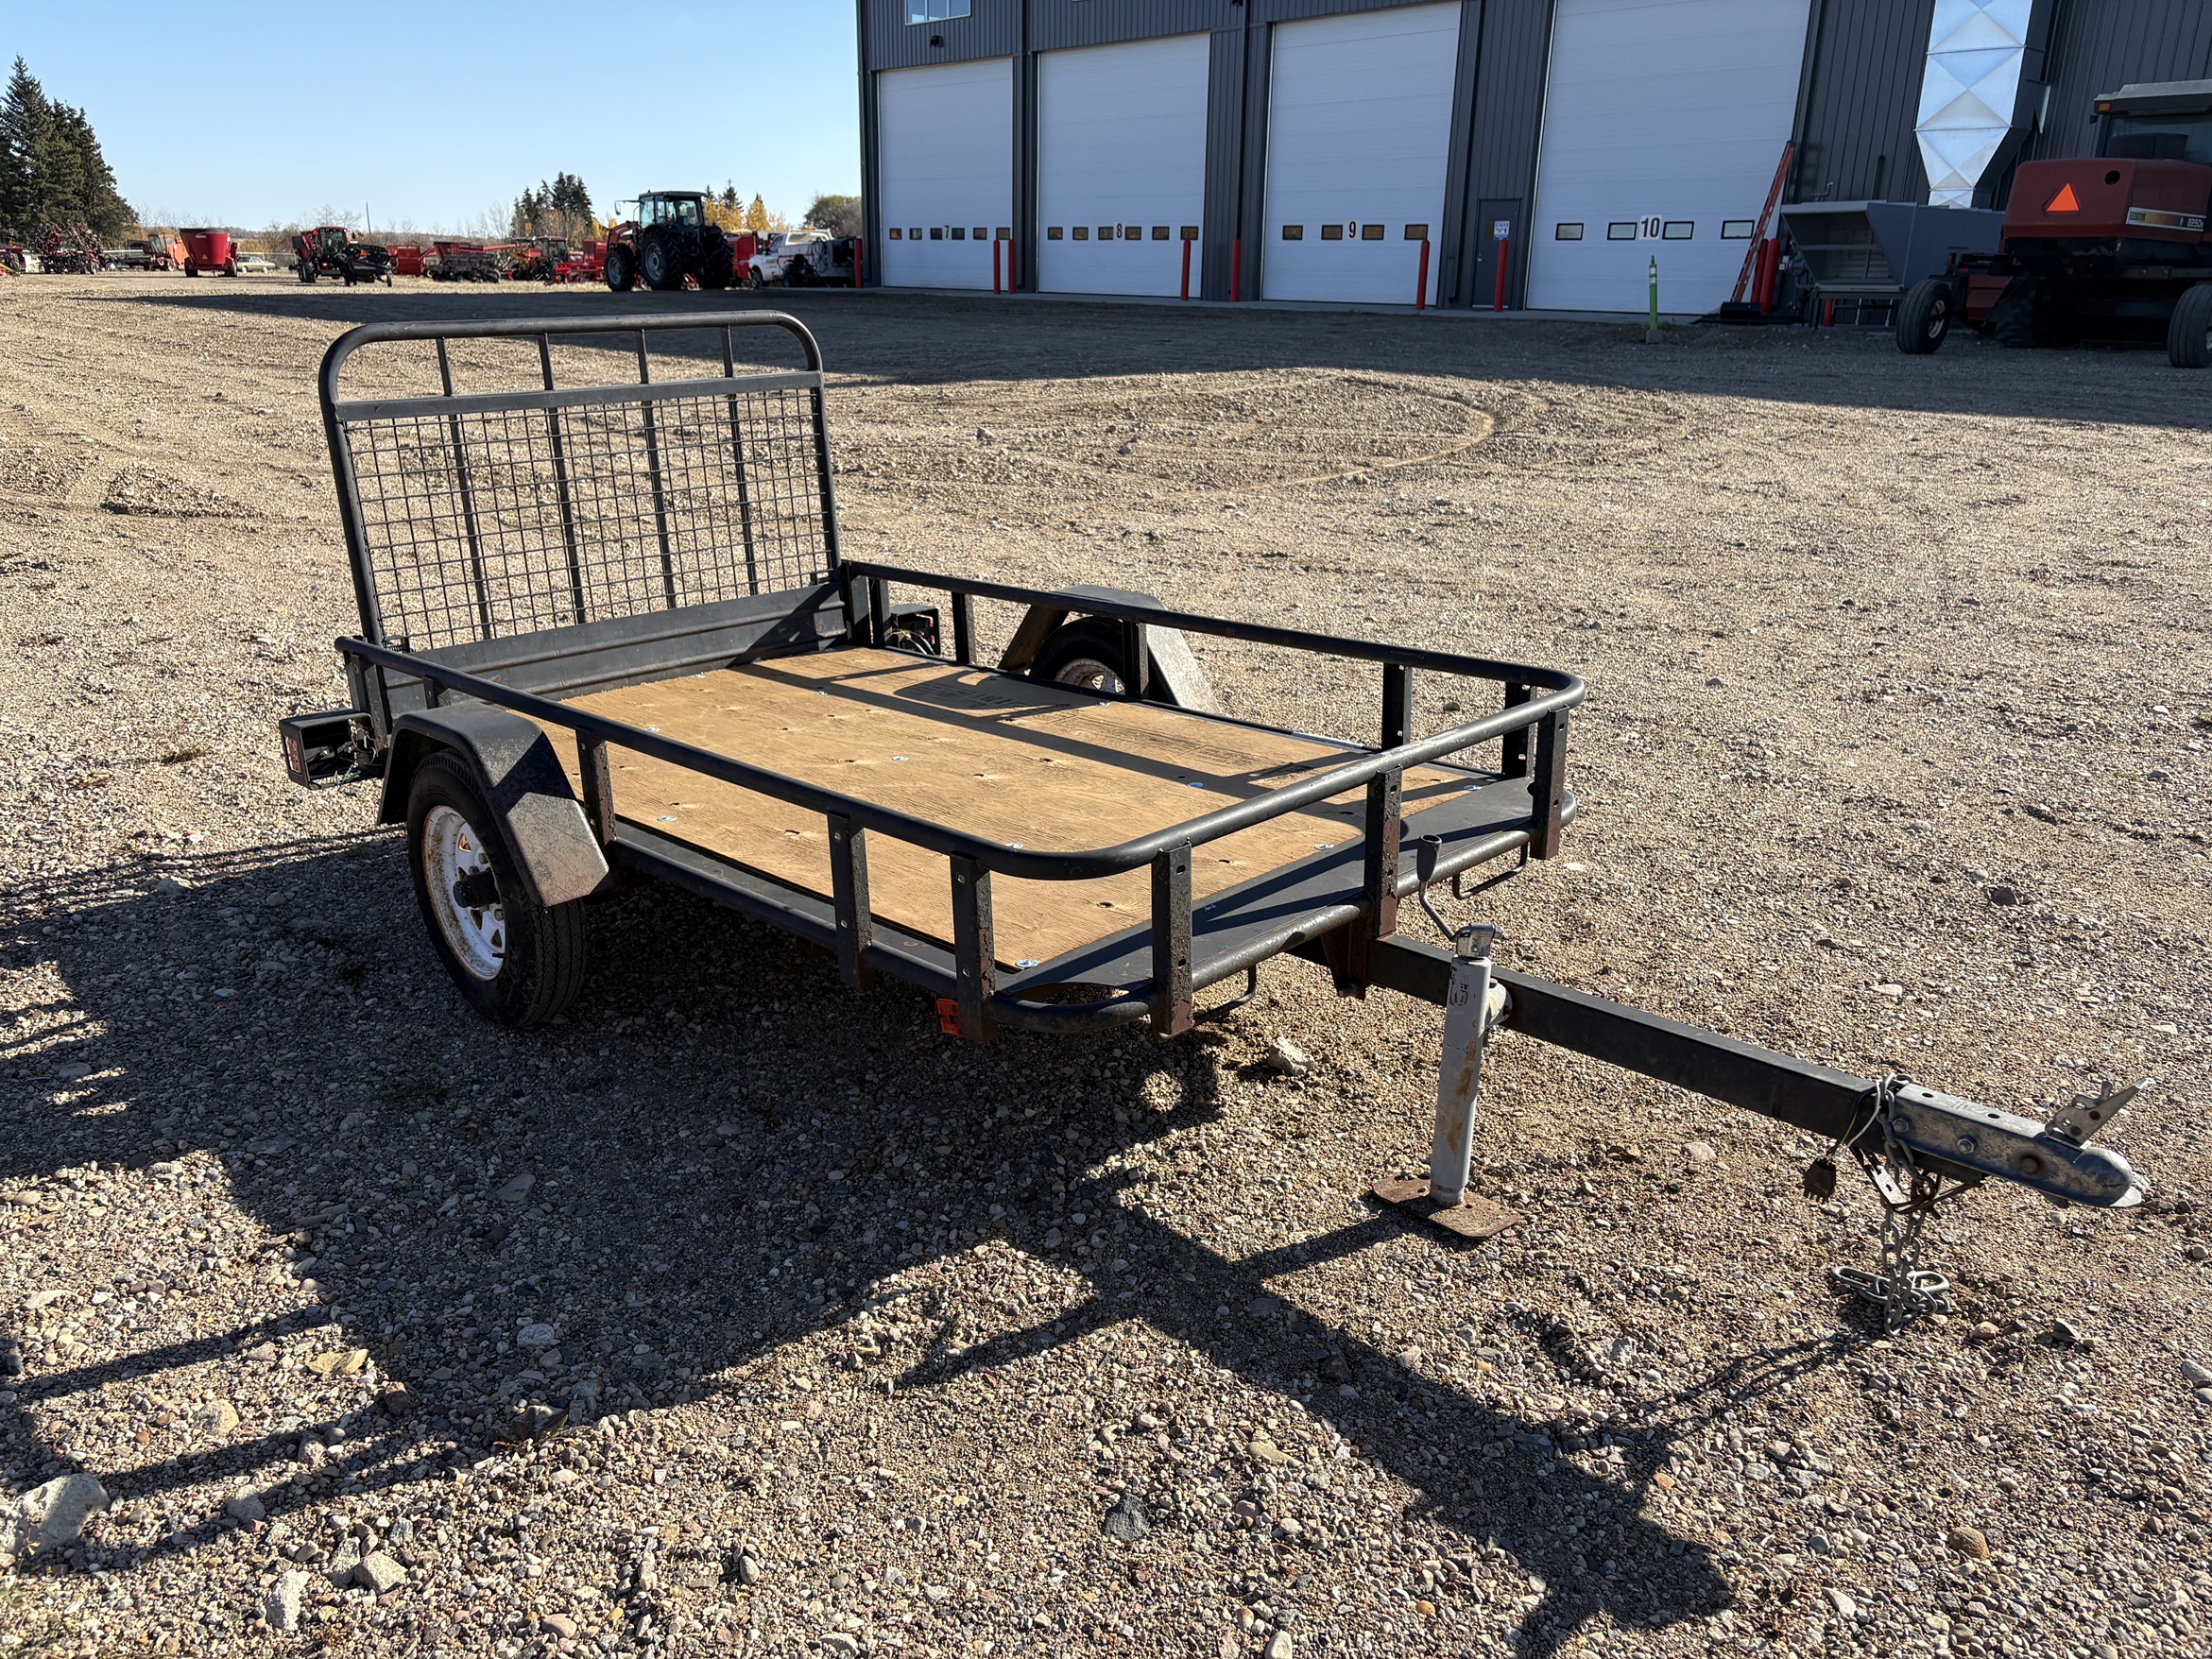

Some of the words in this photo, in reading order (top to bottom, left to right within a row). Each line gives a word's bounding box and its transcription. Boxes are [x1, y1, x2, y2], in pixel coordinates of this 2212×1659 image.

[944, 225, 950, 239] 7
[1116, 223, 1123, 238] 8
[1348, 220, 1357, 238] 9
[1641, 217, 1660, 238] 10
